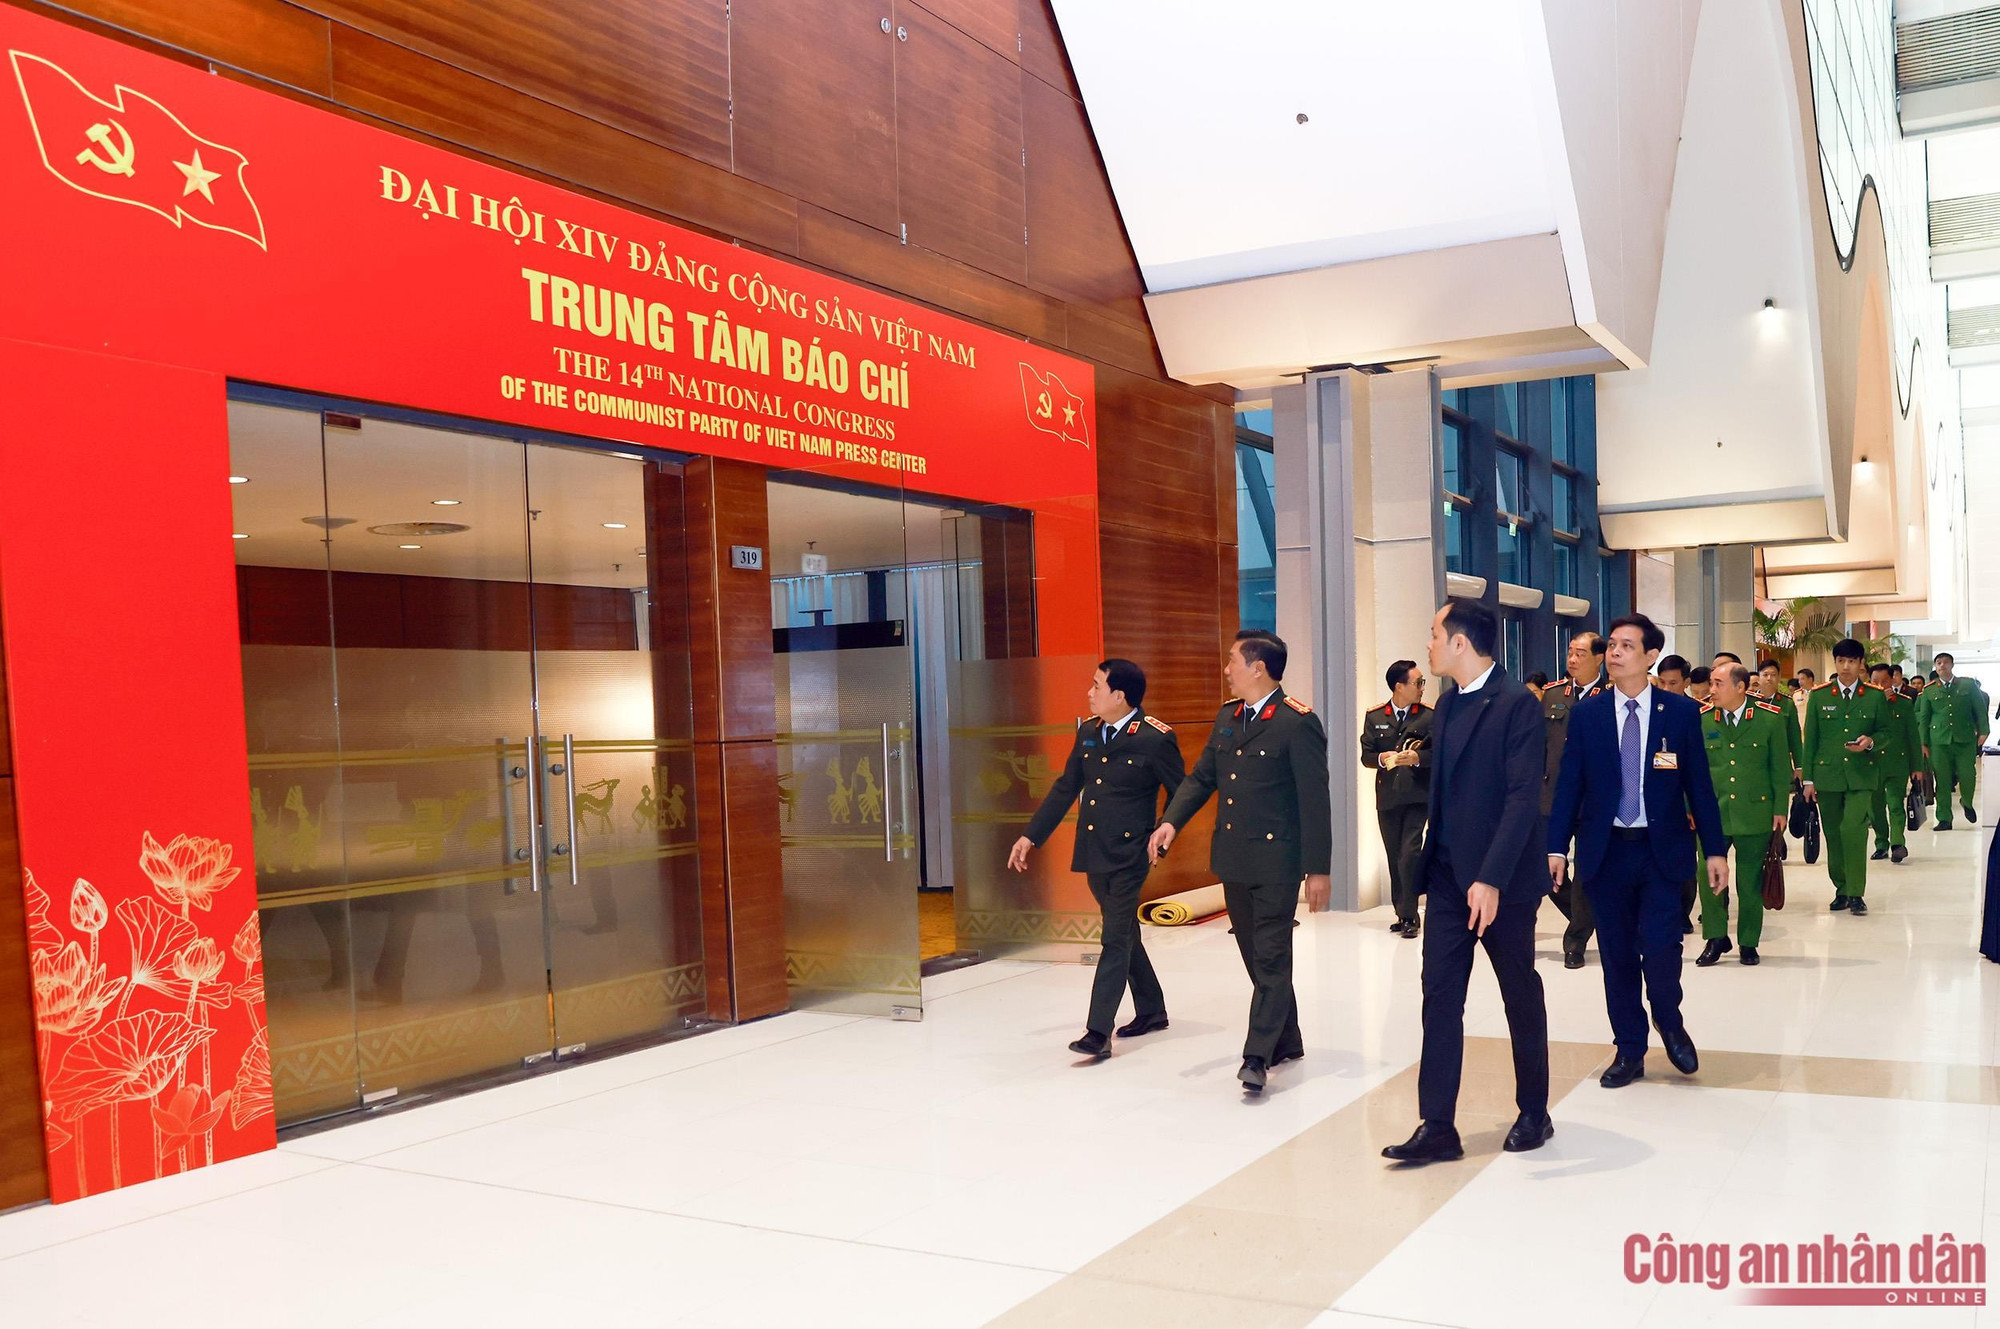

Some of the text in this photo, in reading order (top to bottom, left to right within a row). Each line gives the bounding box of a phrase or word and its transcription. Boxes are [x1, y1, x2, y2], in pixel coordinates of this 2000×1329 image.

[379, 165, 976, 369] ĐẠI HỘI XIV ĐẢNG CỘNG SẢN VIỆT NAM
[521, 267, 910, 409] TRUNG TÂM BÁO CHÍ
[500, 375, 927, 475] OF THE COMMUNIST PARTY OF VIET NAM PRESS CENTER
[553, 346, 611, 383] THE
[667, 371, 788, 420] NATIONAL
[793, 399, 896, 442] CONGRESS
[740, 550, 757, 565] 319
